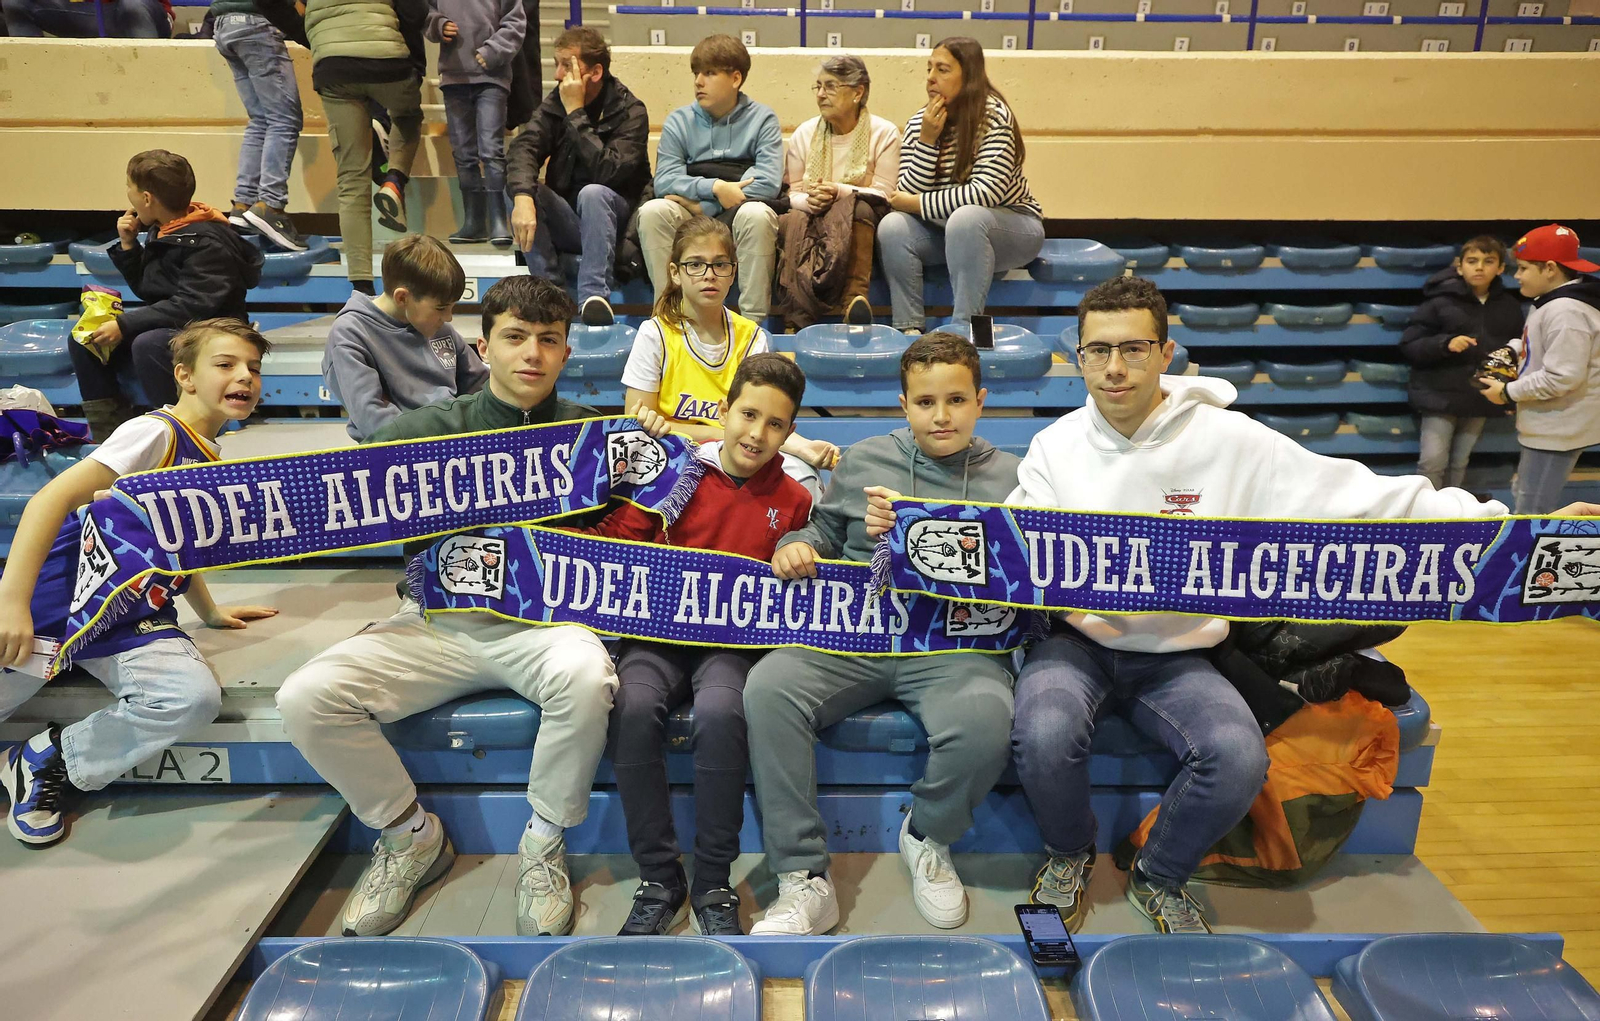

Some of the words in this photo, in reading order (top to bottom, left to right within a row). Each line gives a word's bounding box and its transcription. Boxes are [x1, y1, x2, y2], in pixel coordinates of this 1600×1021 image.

[1367, 5, 1386, 14] 10
[1444, 5, 1461, 14] 11
[1522, 6, 1540, 15] 12
[1427, 42, 1445, 51] 10
[1509, 42, 1527, 51] 11
[431, 338, 454, 354] SURF
[136, 480, 297, 553] UDEA
[321, 443, 574, 531] ALGECIRAS
[1025, 530, 1155, 593] UDEA
[1181, 540, 1483, 603] ALGECIRAS
[542, 552, 651, 619] UDEA
[673, 570, 909, 635] ALGECIRAS
[199, 751, 223, 782] 2
